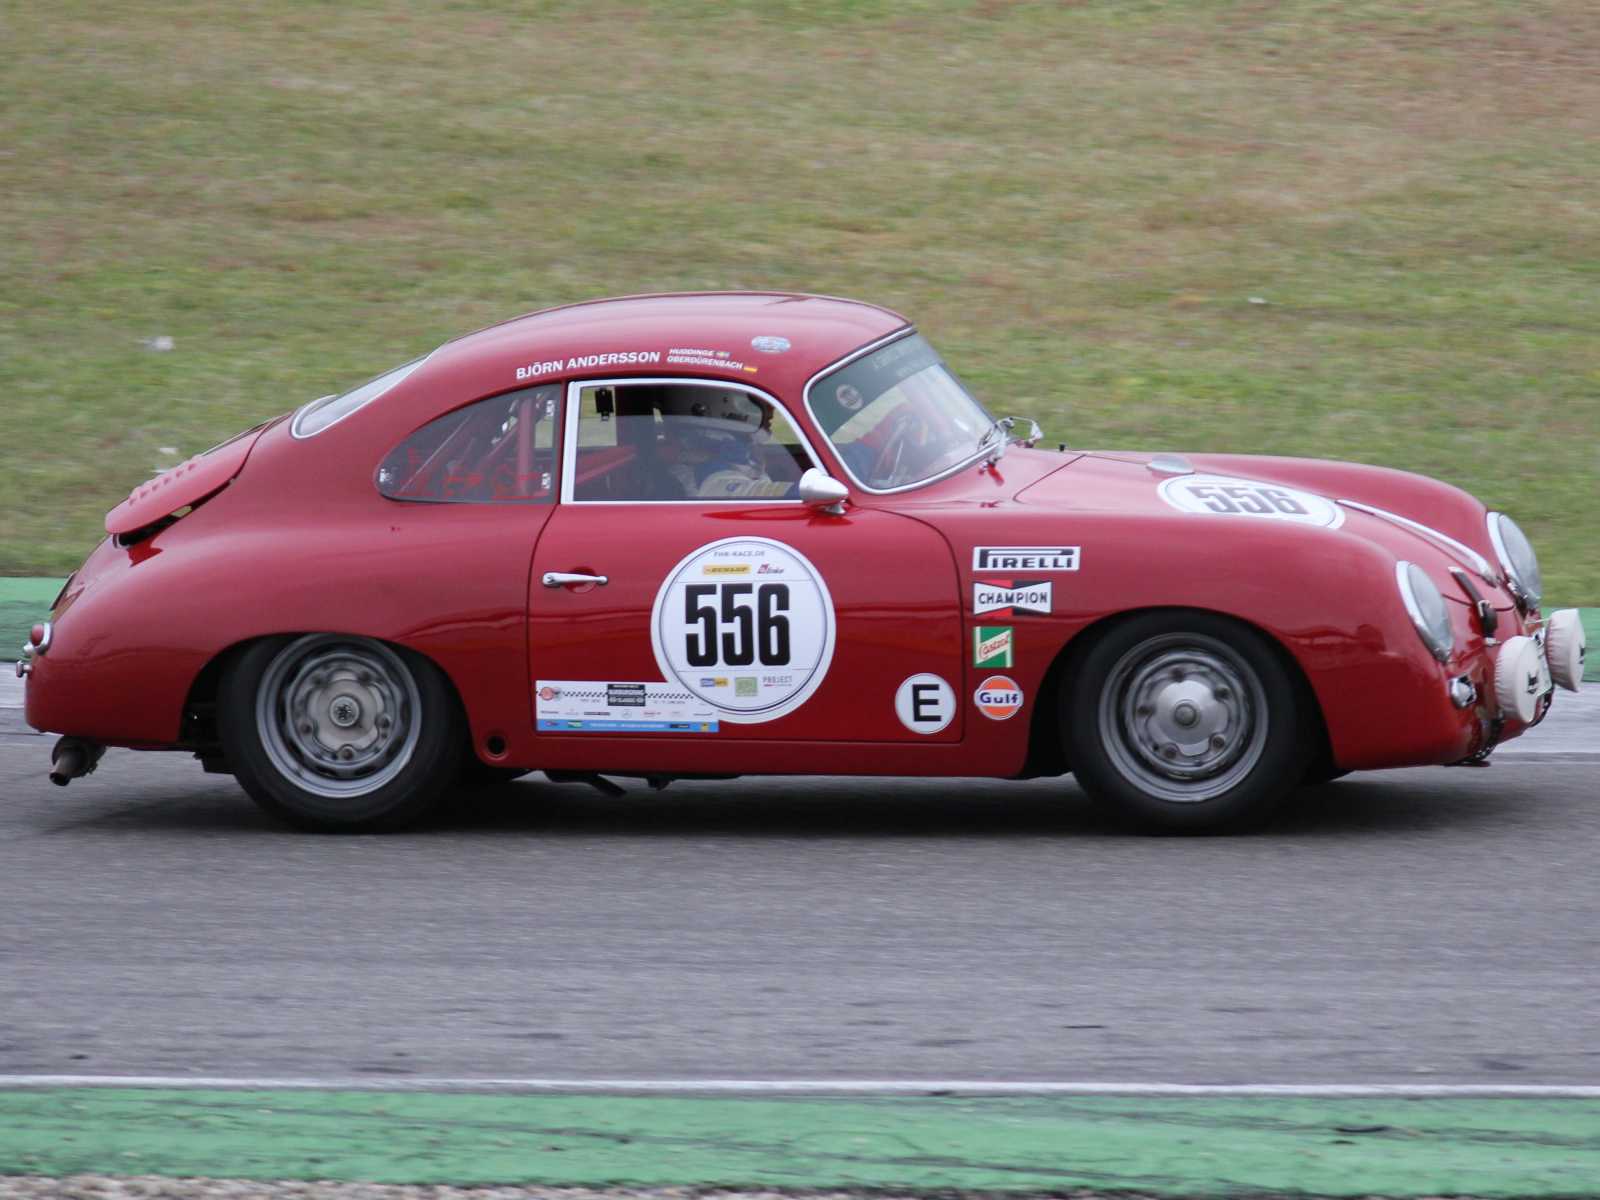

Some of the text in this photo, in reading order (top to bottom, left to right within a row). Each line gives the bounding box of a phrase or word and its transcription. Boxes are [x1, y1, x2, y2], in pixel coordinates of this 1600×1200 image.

[666, 355, 743, 369] OBERDÜRENBACH
[669, 348, 714, 356] HUDDINGE
[516, 352, 660, 379] BJÖRN ANDERSSON
[1186, 486, 1309, 514] 556
[978, 549, 1074, 568] PIRELLI
[978, 592, 1048, 605] CHAMPION
[685, 583, 790, 667] 556
[979, 634, 1010, 660] Castrol
[912, 684, 942, 722] E
[979, 692, 1019, 704] Gulf
